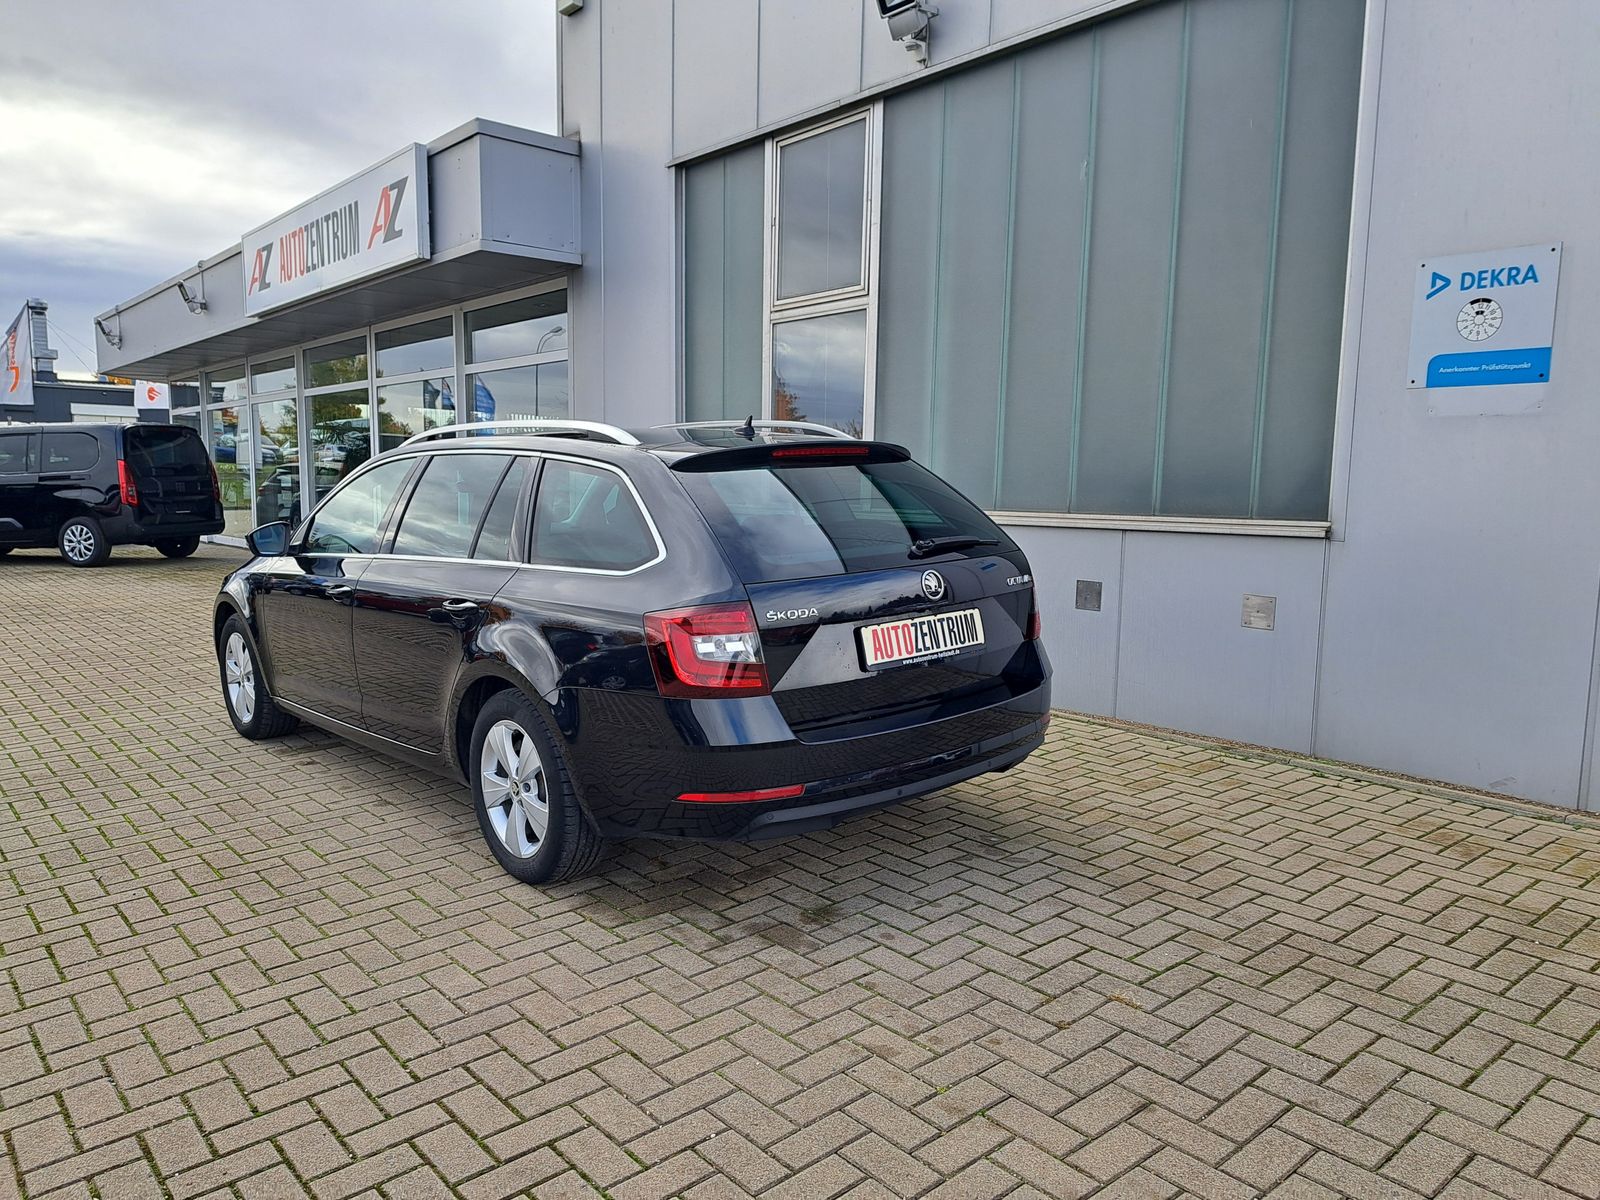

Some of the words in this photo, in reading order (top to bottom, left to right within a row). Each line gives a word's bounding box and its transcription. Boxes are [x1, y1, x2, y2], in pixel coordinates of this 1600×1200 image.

[248, 241, 274, 296] AZ
[279, 200, 360, 284] AUTOZENTRUM
[367, 176, 409, 250] AZ
[1460, 263, 1539, 292] DEKRA
[1439, 365, 1480, 374] Anerkannter
[766, 607, 819, 622] ŠKODA
[871, 612, 979, 662] AUTOZENTRUM
